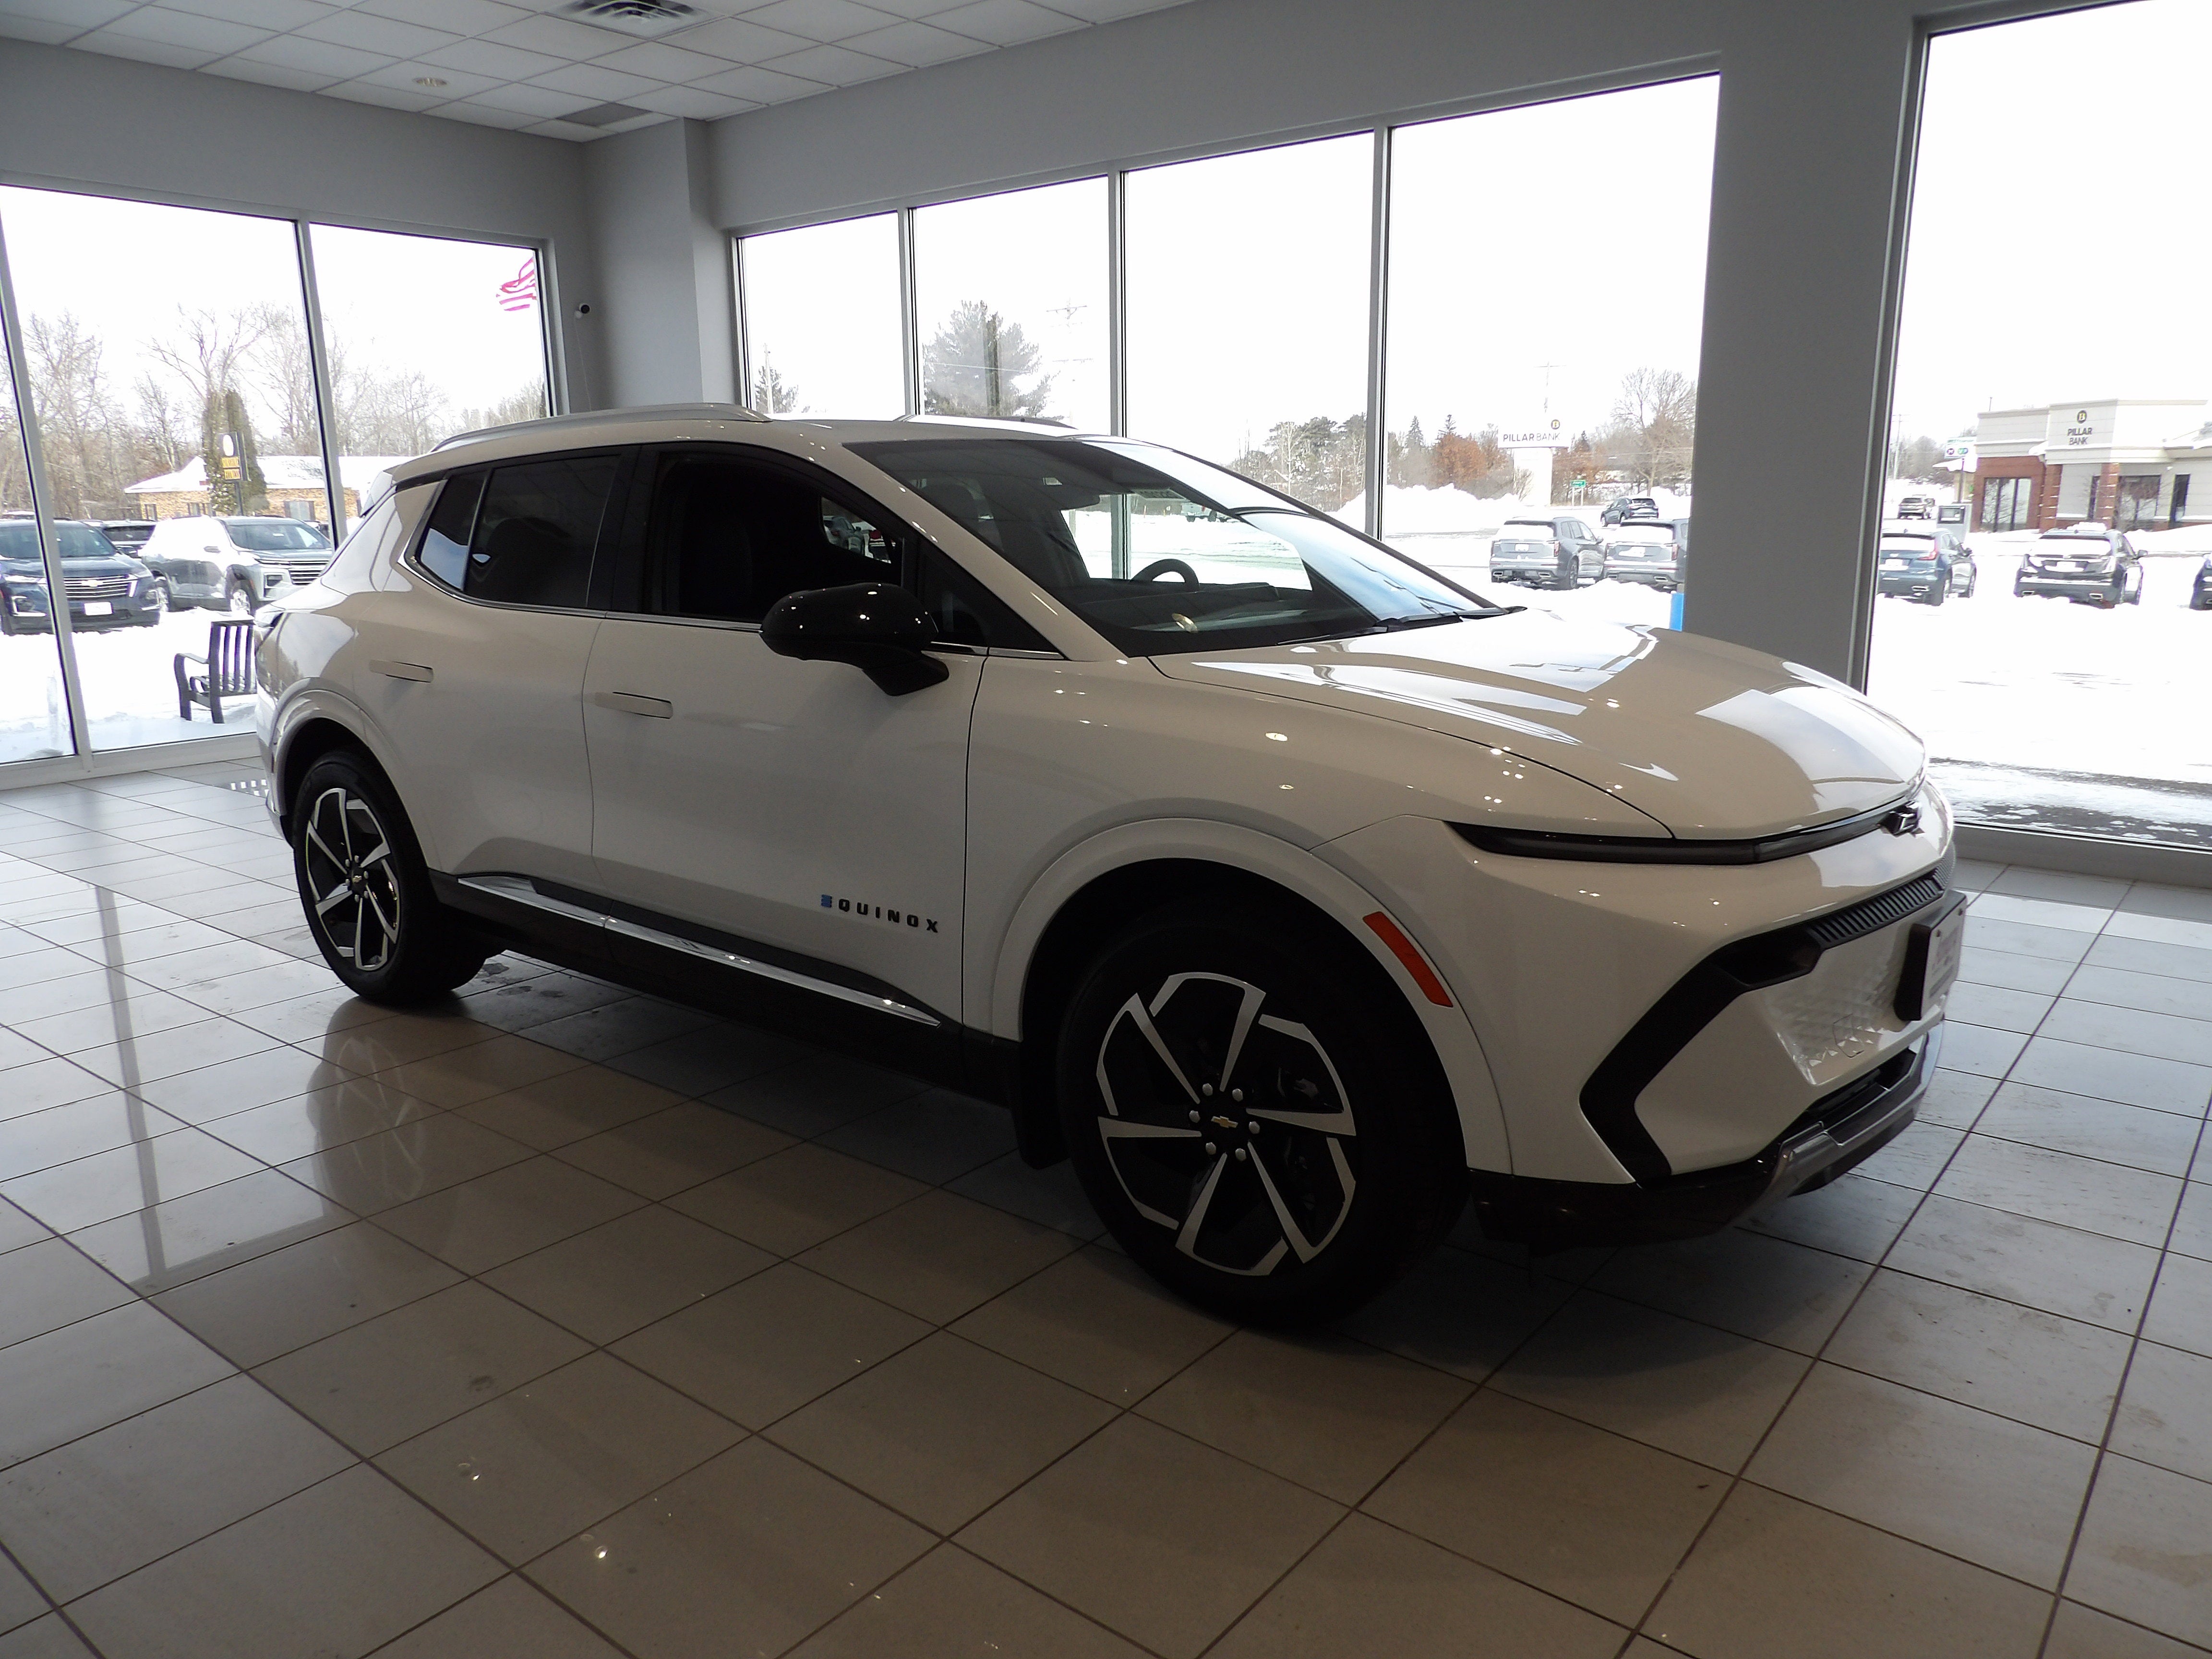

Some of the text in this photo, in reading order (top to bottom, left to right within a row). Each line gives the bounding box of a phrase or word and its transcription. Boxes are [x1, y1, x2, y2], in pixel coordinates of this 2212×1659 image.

[2067, 428, 2092, 436] PILLAR
[1503, 433, 1560, 442] PILLAR BANK
[2069, 437, 2088, 445] BANK
[821, 894, 938, 933] EQUINOX
